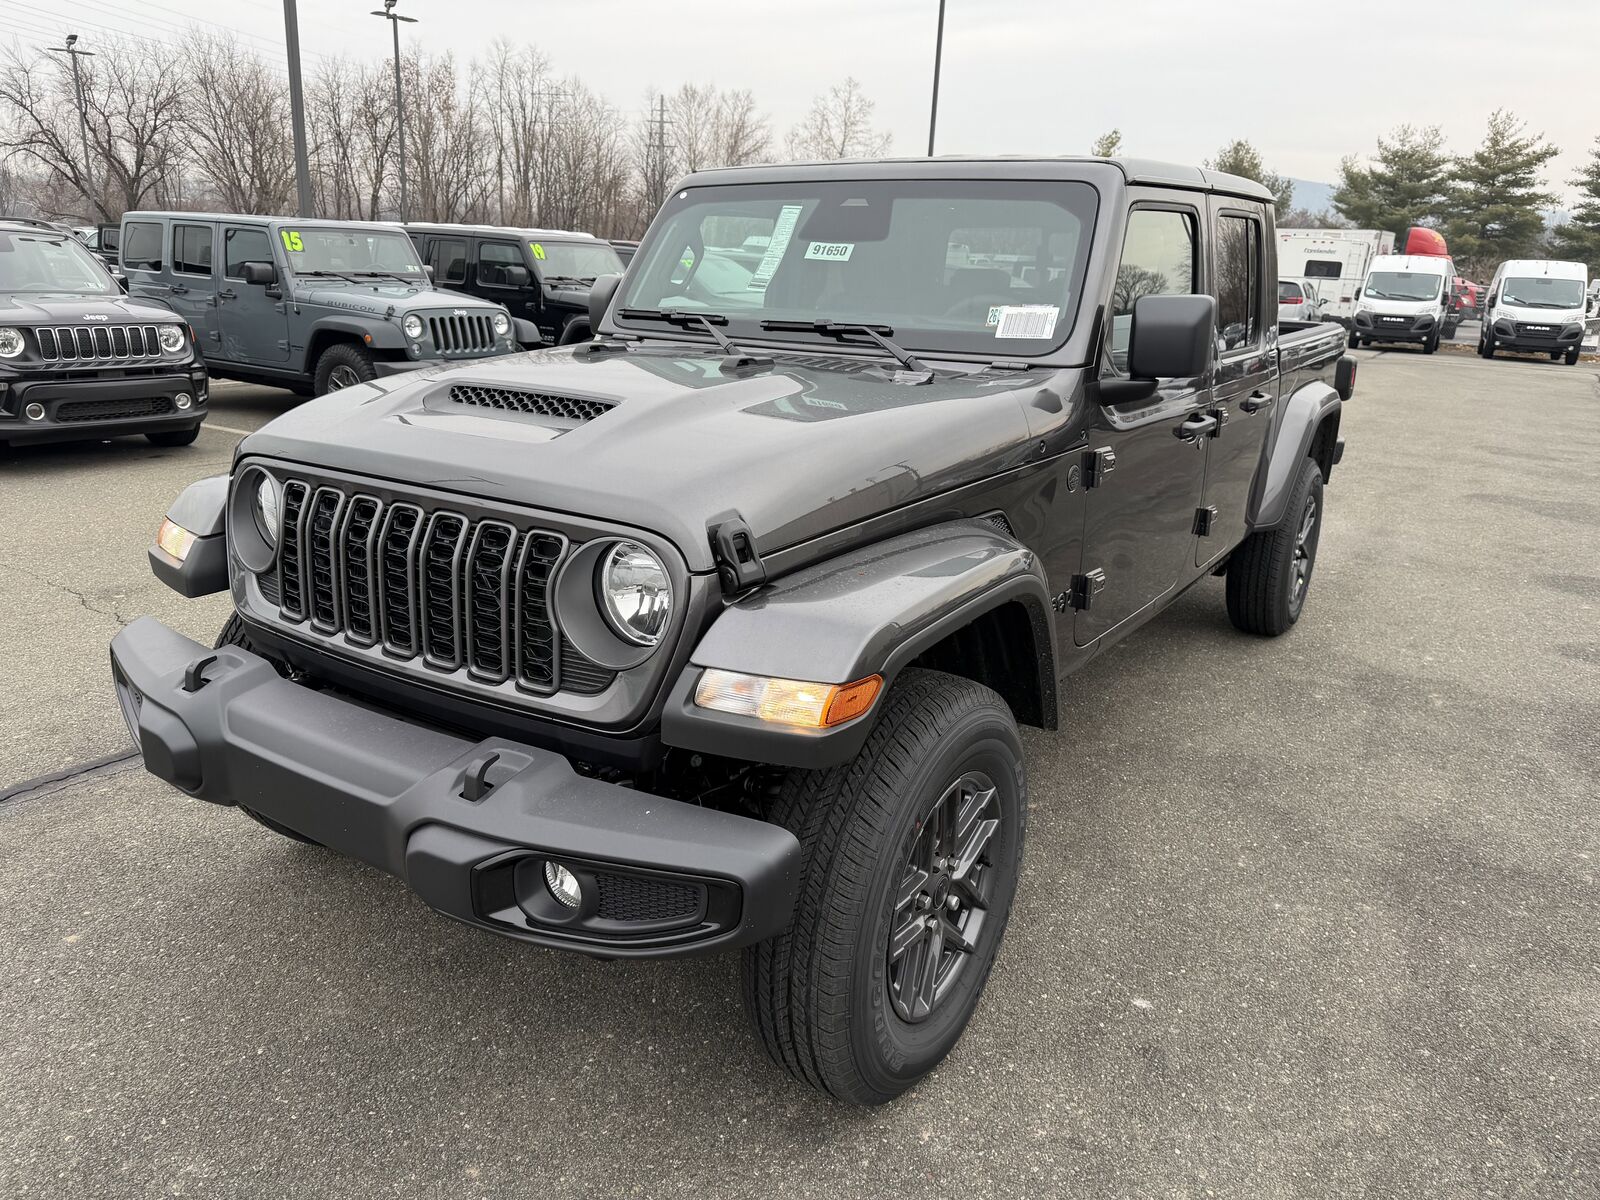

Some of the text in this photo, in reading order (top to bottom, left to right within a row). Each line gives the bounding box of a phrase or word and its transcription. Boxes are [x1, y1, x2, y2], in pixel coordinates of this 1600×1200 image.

[281, 230, 304, 252] 15
[812, 244, 848, 257] 91650
[327, 300, 376, 313] RUBICON
